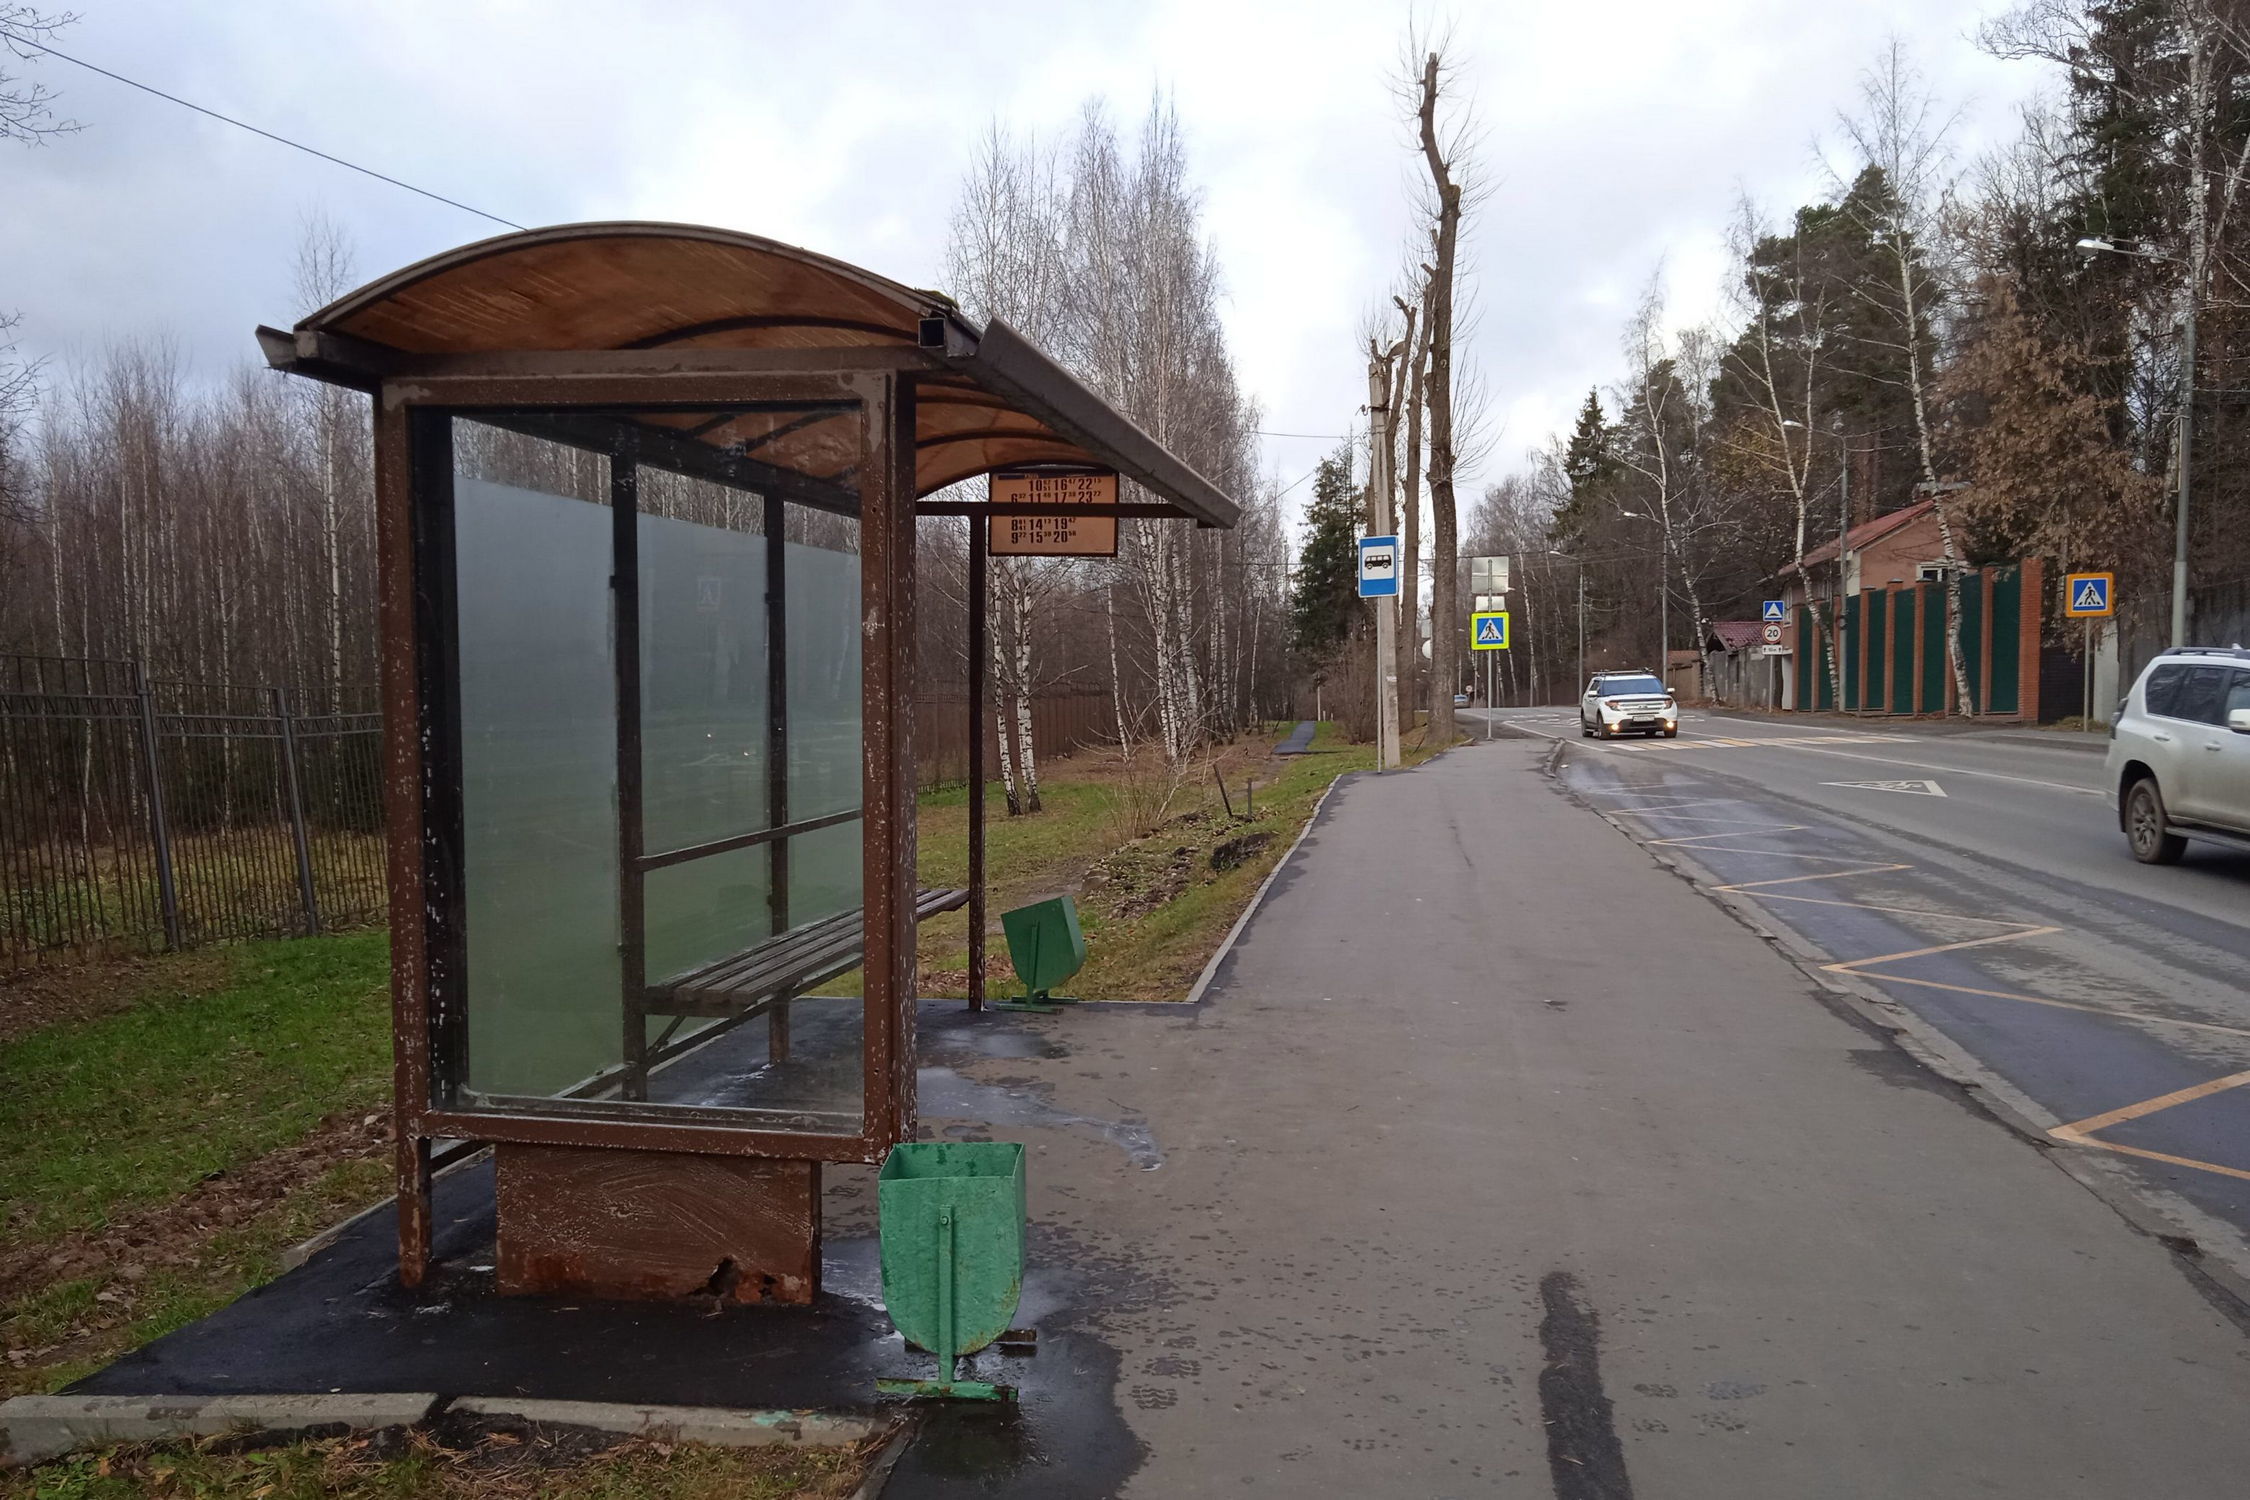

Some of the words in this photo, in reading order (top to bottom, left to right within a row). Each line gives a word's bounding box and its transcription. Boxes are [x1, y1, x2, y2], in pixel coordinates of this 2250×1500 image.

[1028, 479, 1042, 491] 10
[1054, 478, 1067, 490] 16
[1078, 478, 1092, 489] 22
[1029, 493, 1041, 502] 11
[1054, 492, 1067, 502] 17
[1078, 491, 1092, 502] 23
[1011, 519, 1018, 531] 8
[1029, 518, 1043, 530] 14
[1054, 517, 1068, 529] 19
[1011, 531, 1018, 544] 9
[1029, 531, 1043, 543] 15
[1053, 530, 1068, 543] 20
[1767, 629, 1779, 638] 20
